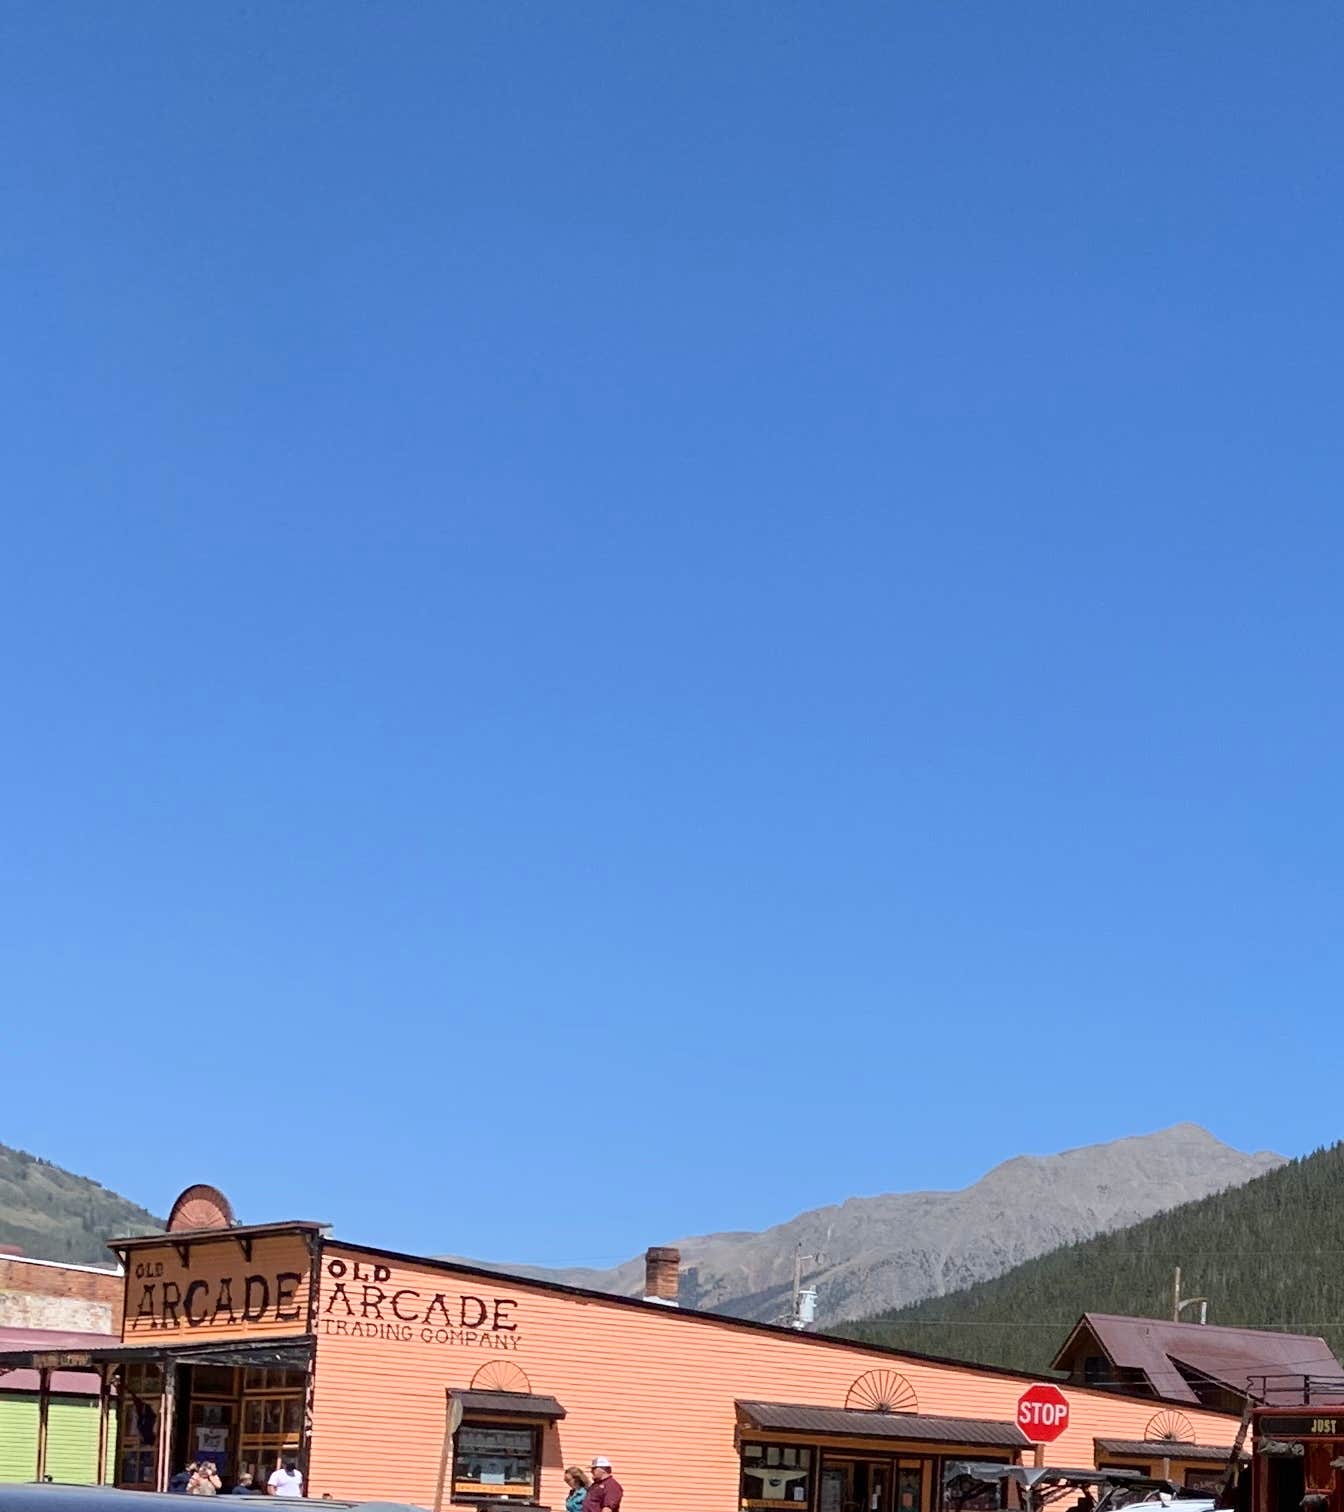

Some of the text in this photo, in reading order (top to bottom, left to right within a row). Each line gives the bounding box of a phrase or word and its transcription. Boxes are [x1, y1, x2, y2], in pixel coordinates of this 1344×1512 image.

[135, 1262, 164, 1279] OLD
[327, 1259, 391, 1282] OLD
[132, 1271, 303, 1328] ARCADE
[323, 1283, 518, 1331] ARCADE
[320, 1318, 522, 1350] TRADING COMPANY
[1020, 1401, 1067, 1426] STOP
[1311, 1418, 1337, 1434] JUST
